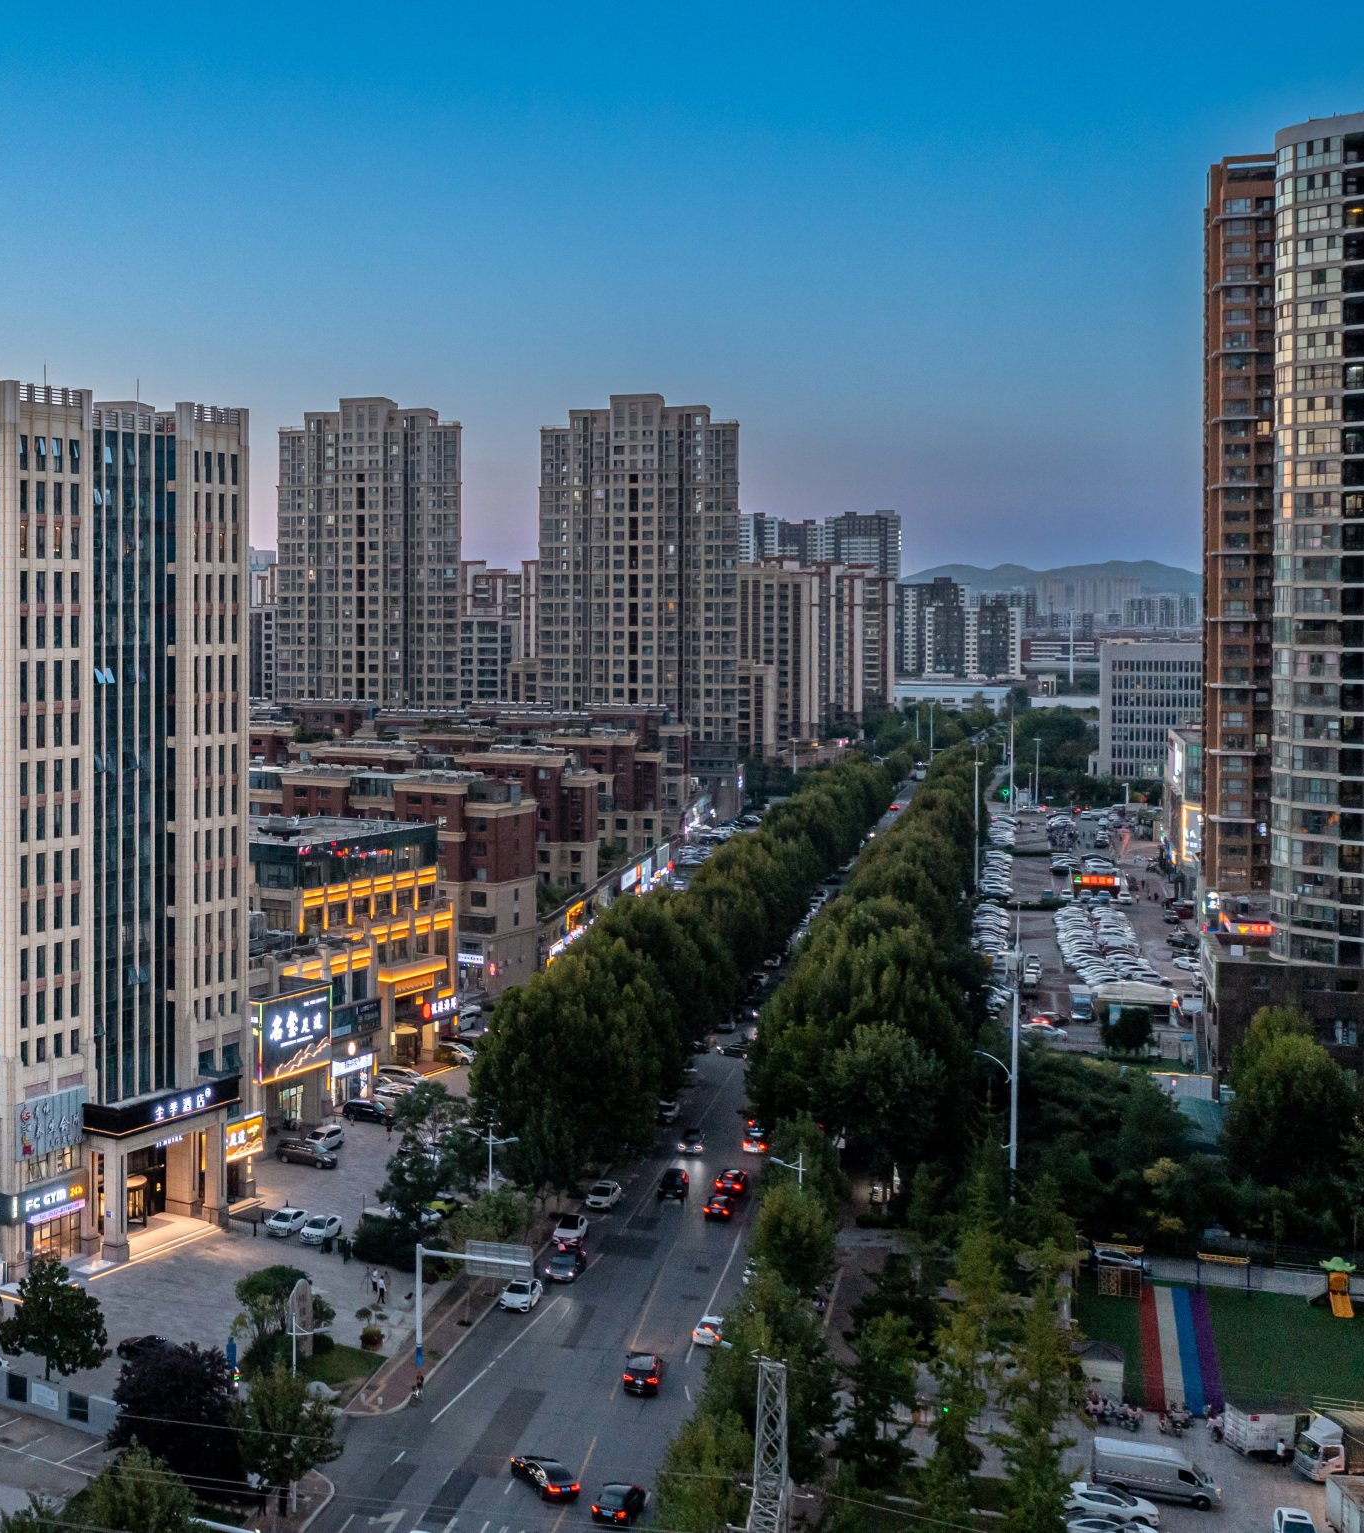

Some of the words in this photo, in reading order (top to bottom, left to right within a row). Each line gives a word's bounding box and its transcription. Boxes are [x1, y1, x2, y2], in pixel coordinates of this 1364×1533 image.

[155, 1093, 205, 1122] 全季酒店
[25, 1197, 40, 1212] FC
[43, 1188, 67, 1205] GYM
[69, 1185, 83, 1198] 24h
